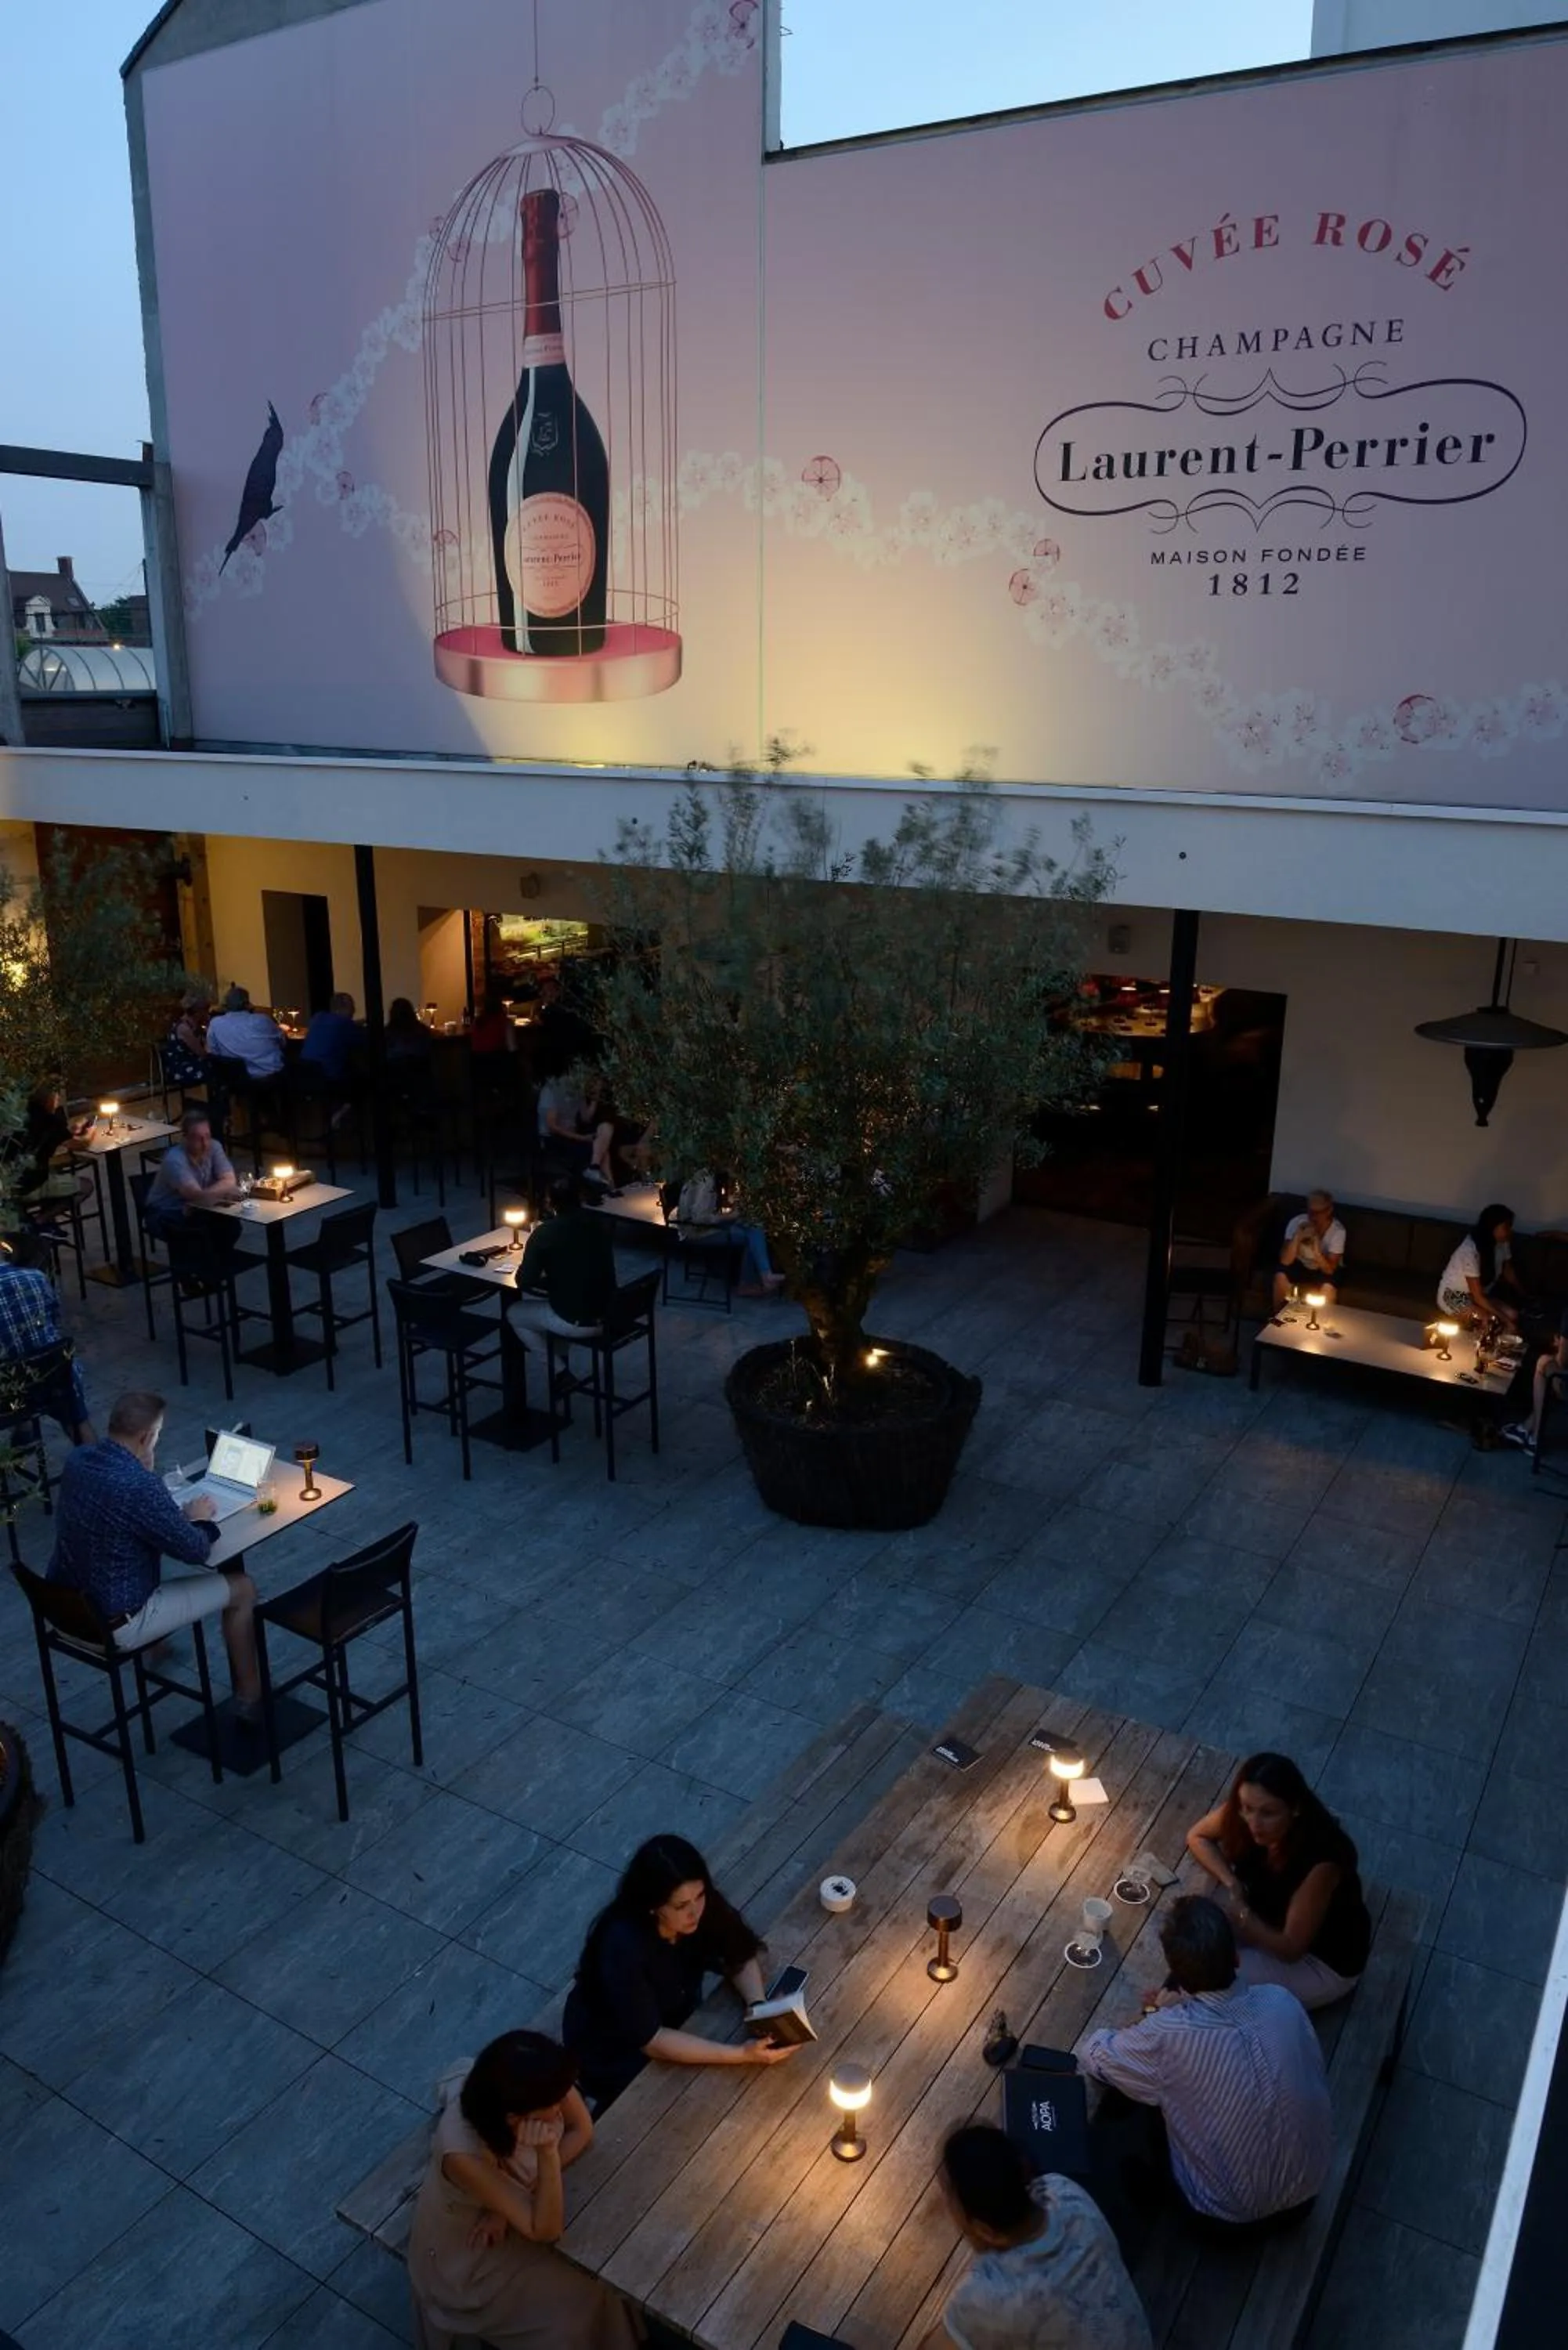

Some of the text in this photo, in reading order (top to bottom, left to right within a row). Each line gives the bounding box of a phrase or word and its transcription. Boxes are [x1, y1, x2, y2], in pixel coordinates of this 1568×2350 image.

[1103, 212, 1471, 320] CUVÉE ROSÉ
[1147, 318, 1405, 362] CHAMPAGNE
[1058, 422, 1496, 482] Laurent-Perrier
[1151, 544, 1367, 565] MAISON FONDÉE
[1209, 573, 1300, 596] 1812
[1039, 2100, 1053, 2131] AOPA
